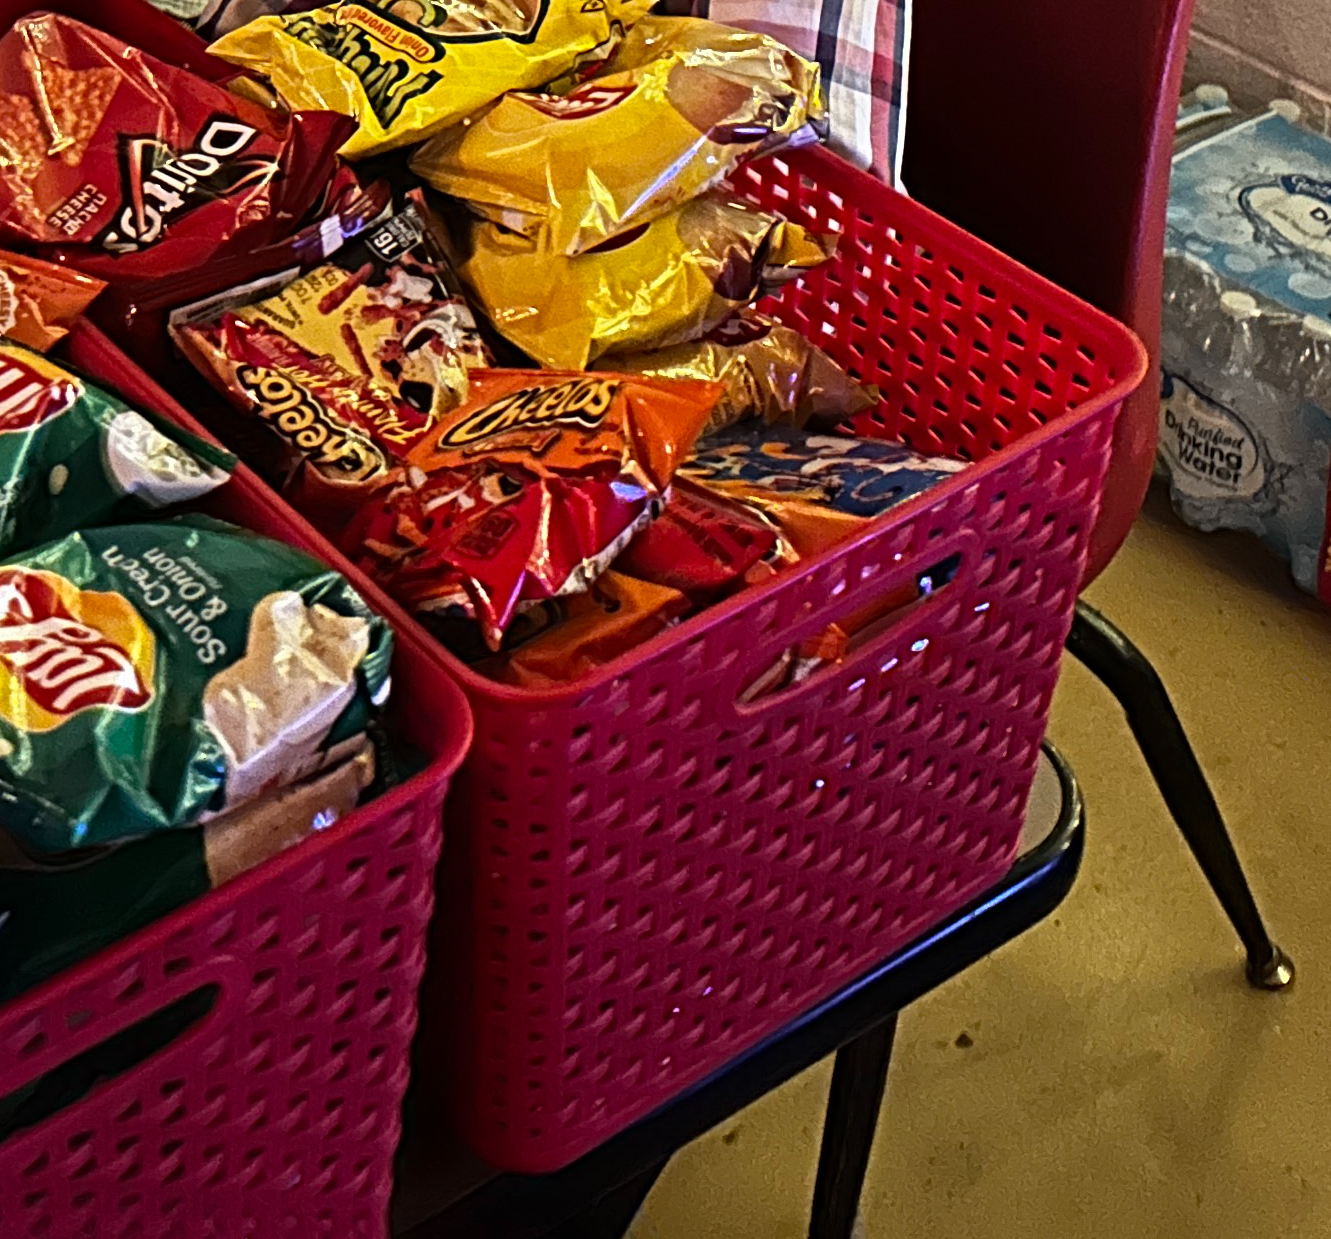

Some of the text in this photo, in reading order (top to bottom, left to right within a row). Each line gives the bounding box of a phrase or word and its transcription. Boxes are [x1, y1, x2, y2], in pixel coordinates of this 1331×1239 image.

[47, 183, 100, 229] CHEESE
[101, 120, 257, 254] Doritos
[237, 364, 383, 482] Cheetos
[447, 377, 619, 445] Cheetos
[1165, 409, 1243, 471] Drinking
[1179, 438, 1242, 484] Water
[143, 547, 207, 601] Onion
[165, 603, 228, 664] Sour
[200, 595, 228, 621] &
